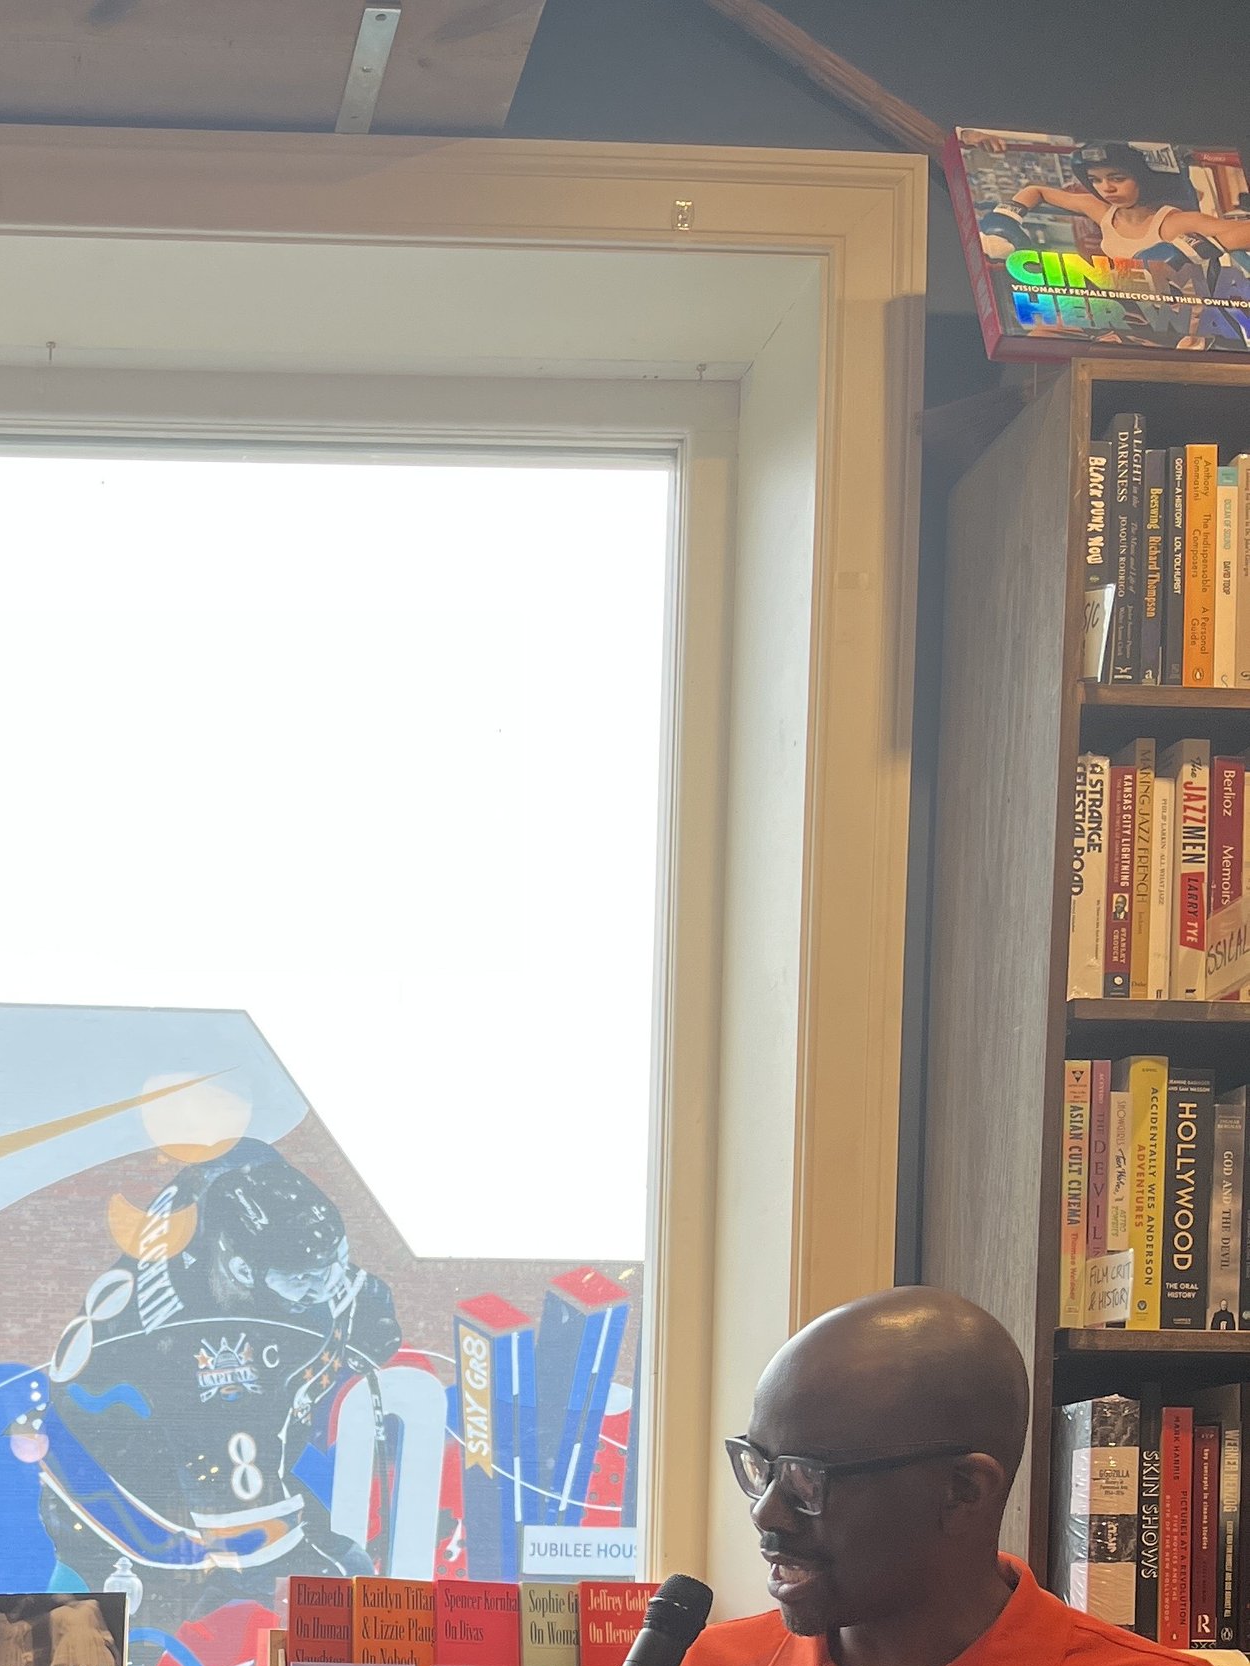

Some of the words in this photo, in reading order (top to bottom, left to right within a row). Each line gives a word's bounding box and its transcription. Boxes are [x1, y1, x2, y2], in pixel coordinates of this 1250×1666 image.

[1012, 284, 1067, 296] VISIONARY
[1069, 287, 1106, 298] FEMALE
[1109, 291, 1161, 303] DIRECTORS
[1162, 295, 1173, 303] IN
[1174, 296, 1202, 305] THEIR
[1204, 298, 1229, 307] OWN
[1012, 291, 1134, 331] HER
[1222, 769, 1236, 817] Berlioz
[1221, 845, 1235, 906] Memoirs
[1186, 877, 1199, 918] LARRY
[1186, 921, 1198, 943] TYE
[1068, 1104, 1084, 1142] ASIAN
[1149, 1087, 1159, 1179] ACCIDENTALLY
[1068, 1145, 1083, 1174] CULT
[1067, 1178, 1083, 1227] CINEMA
[1135, 1144, 1146, 1228] ADVENTURES
[1147, 1183, 1156, 1210] WES
[1172, 1101, 1198, 1272] HOLLYWOOD
[1144, 1213, 1155, 1286] ANDERSON
[262, 1345, 281, 1369] C
[465, 1391, 488, 1456] STAY
[228, 1432, 264, 1500] 8
[1142, 1449, 1160, 1500] SKIN
[529, 1541, 592, 1559] JUBILEE
[1140, 1502, 1160, 1580] SHOWS
[362, 1584, 401, 1613] Kaitlyn
[444, 1588, 480, 1613] Spencer
[529, 1589, 565, 1617] Sophie
[588, 1588, 623, 1616] Jeffrey
[362, 1616, 370, 1639] &
[373, 1617, 405, 1641] Lizzie
[445, 1621, 457, 1641] On
[459, 1621, 484, 1642] Divas
[530, 1621, 544, 1645] On
[589, 1622, 602, 1644] On
